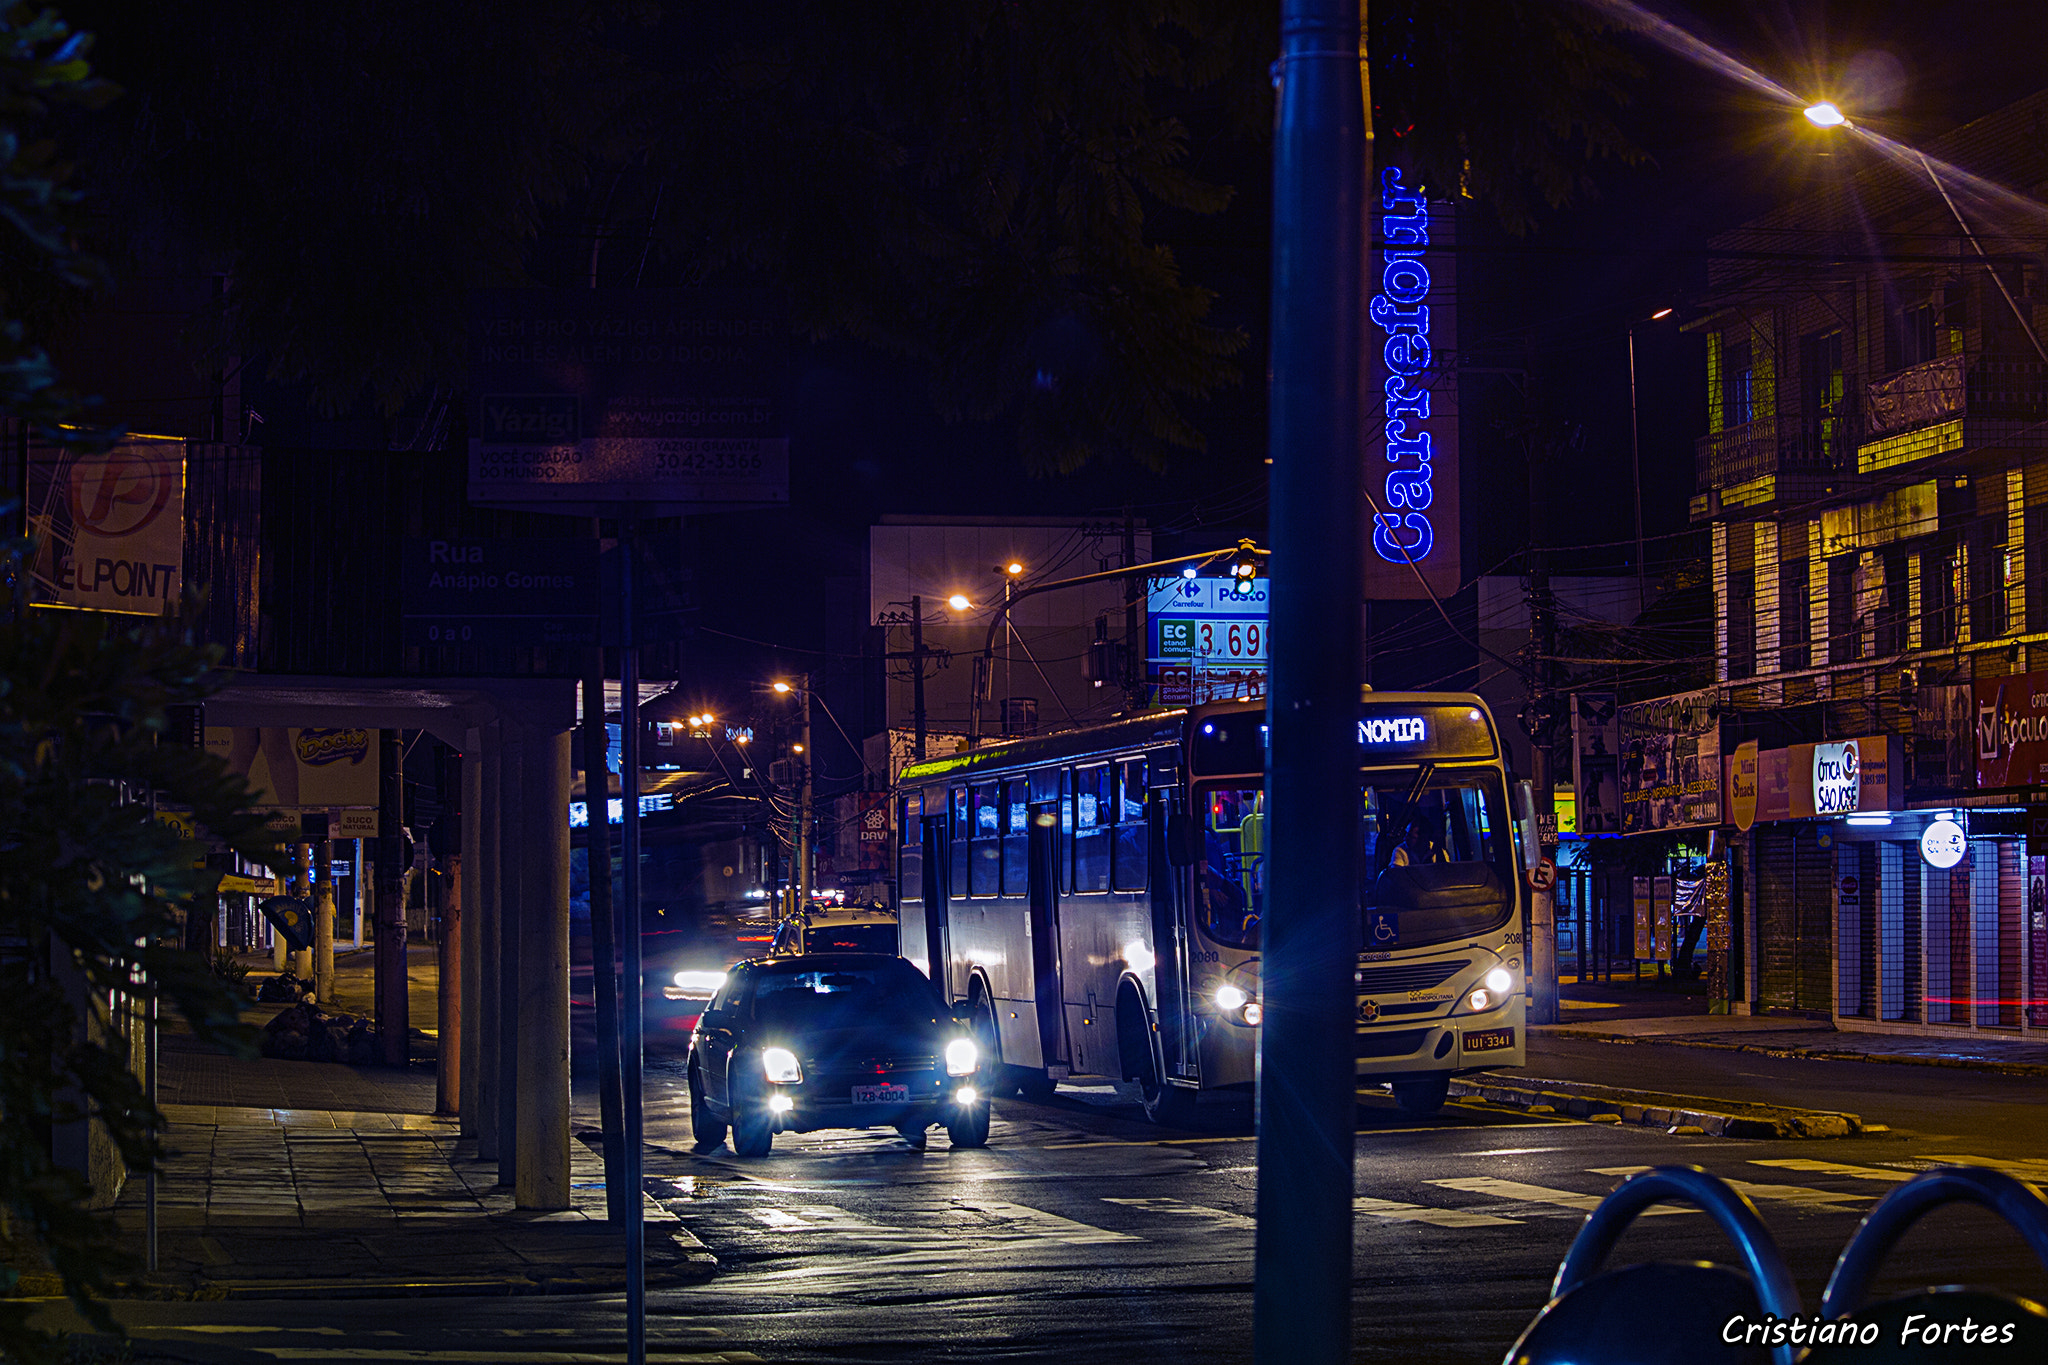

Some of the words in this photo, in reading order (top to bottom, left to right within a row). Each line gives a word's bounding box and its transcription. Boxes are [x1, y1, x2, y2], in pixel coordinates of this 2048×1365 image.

[481, 319, 526, 337] VEM
[535, 319, 577, 337] PRO
[665, 319, 775, 337] APRENDER
[632, 345, 663, 363] DO
[1370, 166, 1433, 563] Carrefour
[608, 408, 772, 426] www.yazigi.com.br
[480, 449, 519, 464] VOCÊ
[522, 449, 582, 464] CIDADÃO
[656, 453, 762, 469] 3042-3366
[480, 467, 499, 478] DO
[429, 540, 484, 563] Rua
[429, 571, 498, 591] Anápio
[505, 571, 574, 589] Gomes
[1218, 587, 1266, 602] Posto
[1172, 600, 1204, 608] Carrefour
[444, 629, 456, 641] a
[1163, 625, 1187, 639] EC
[1162, 671, 1188, 685] GC
[1740, 758, 1755, 774] Mini
[1818, 757, 1841, 782] ÓTICA
[1733, 774, 1755, 798] Snack
[1818, 785, 1836, 811] SÃO
[861, 831, 888, 840] DAVI
[1191, 951, 1219, 962] 2080
[1409, 993, 1454, 1002] METROPOLITANA
